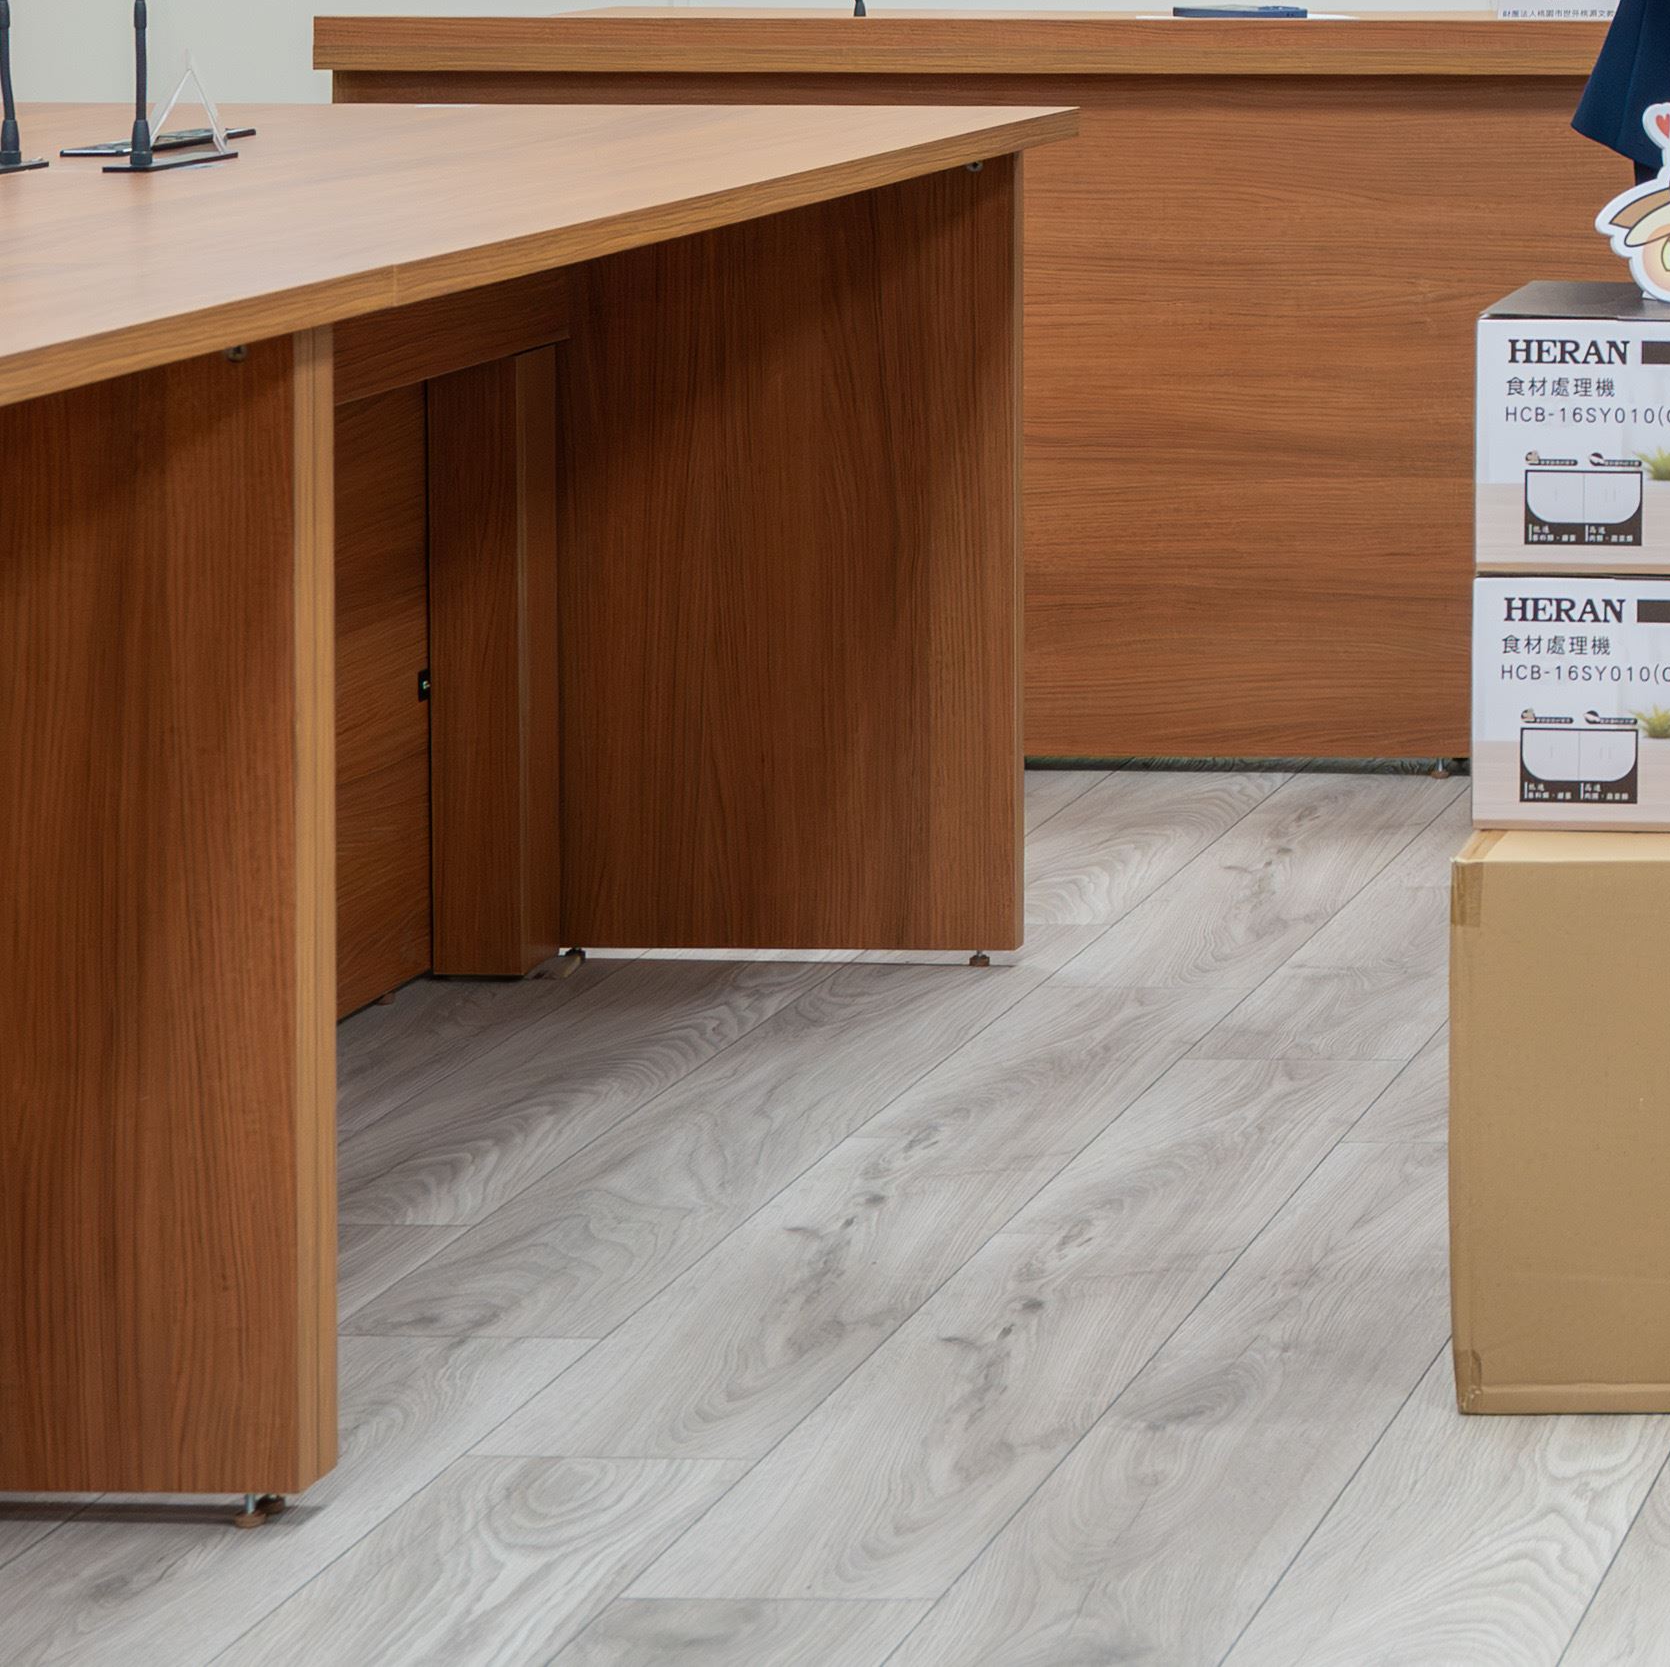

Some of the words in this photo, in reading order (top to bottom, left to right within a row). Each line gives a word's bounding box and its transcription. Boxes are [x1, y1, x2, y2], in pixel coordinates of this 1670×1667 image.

[1508, 339, 1630, 365] HERAN
[1506, 376, 1616, 397] 食材處理機
[1503, 597, 1626, 623] HERAN
[1502, 634, 1611, 656] 食材處理機
